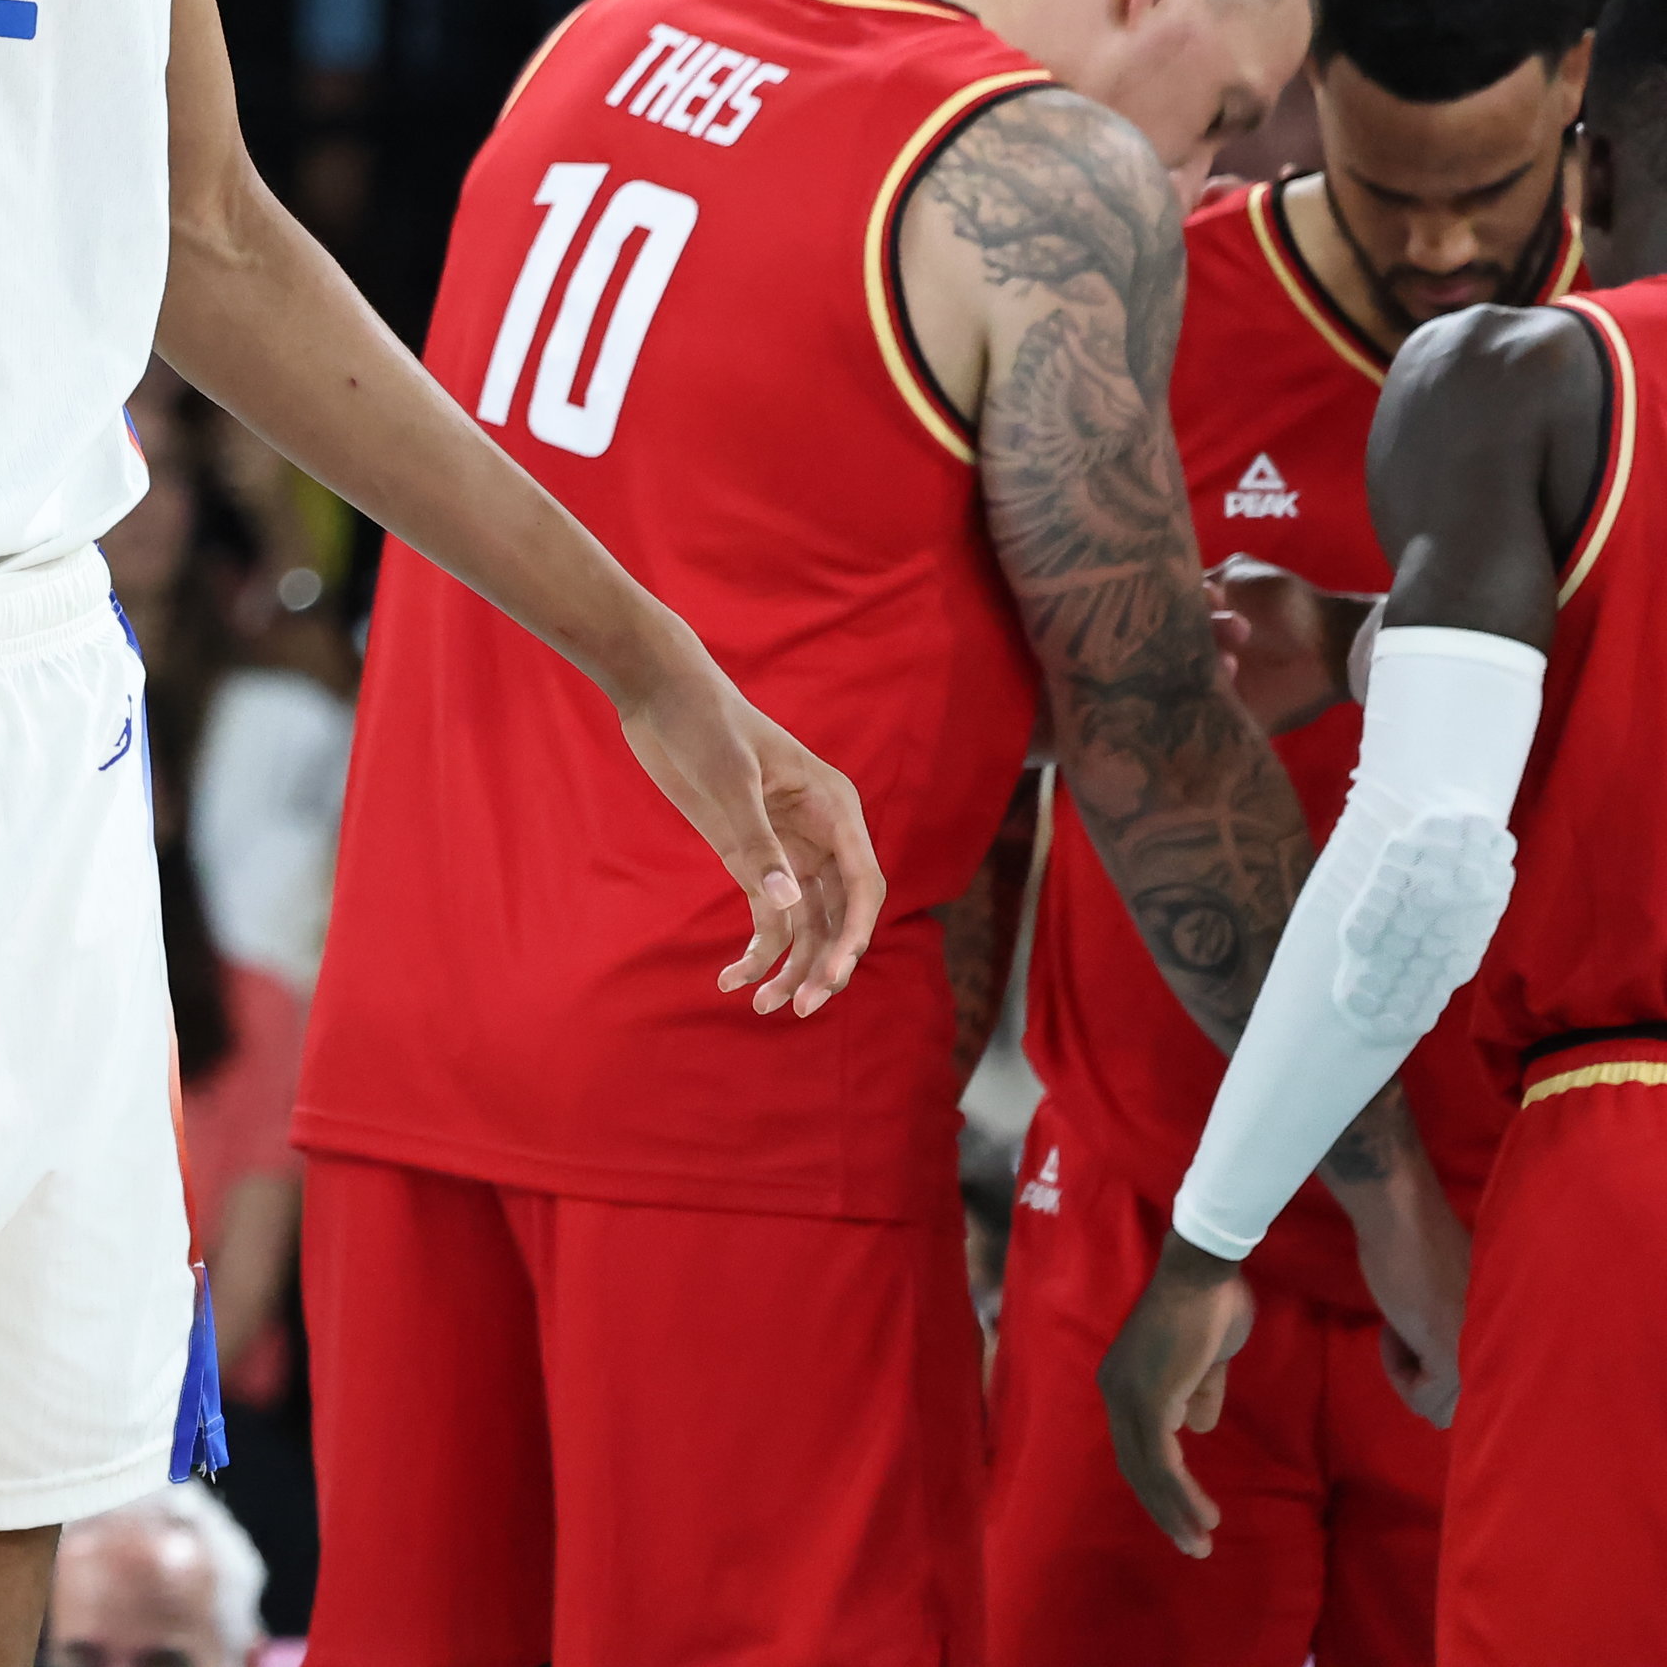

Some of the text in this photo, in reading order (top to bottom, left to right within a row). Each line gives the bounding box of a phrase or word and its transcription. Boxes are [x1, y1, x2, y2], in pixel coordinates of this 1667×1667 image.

[604, 23, 790, 147] THEIS
[476, 162, 699, 459] 10
[1224, 490, 1300, 519] PEAK
